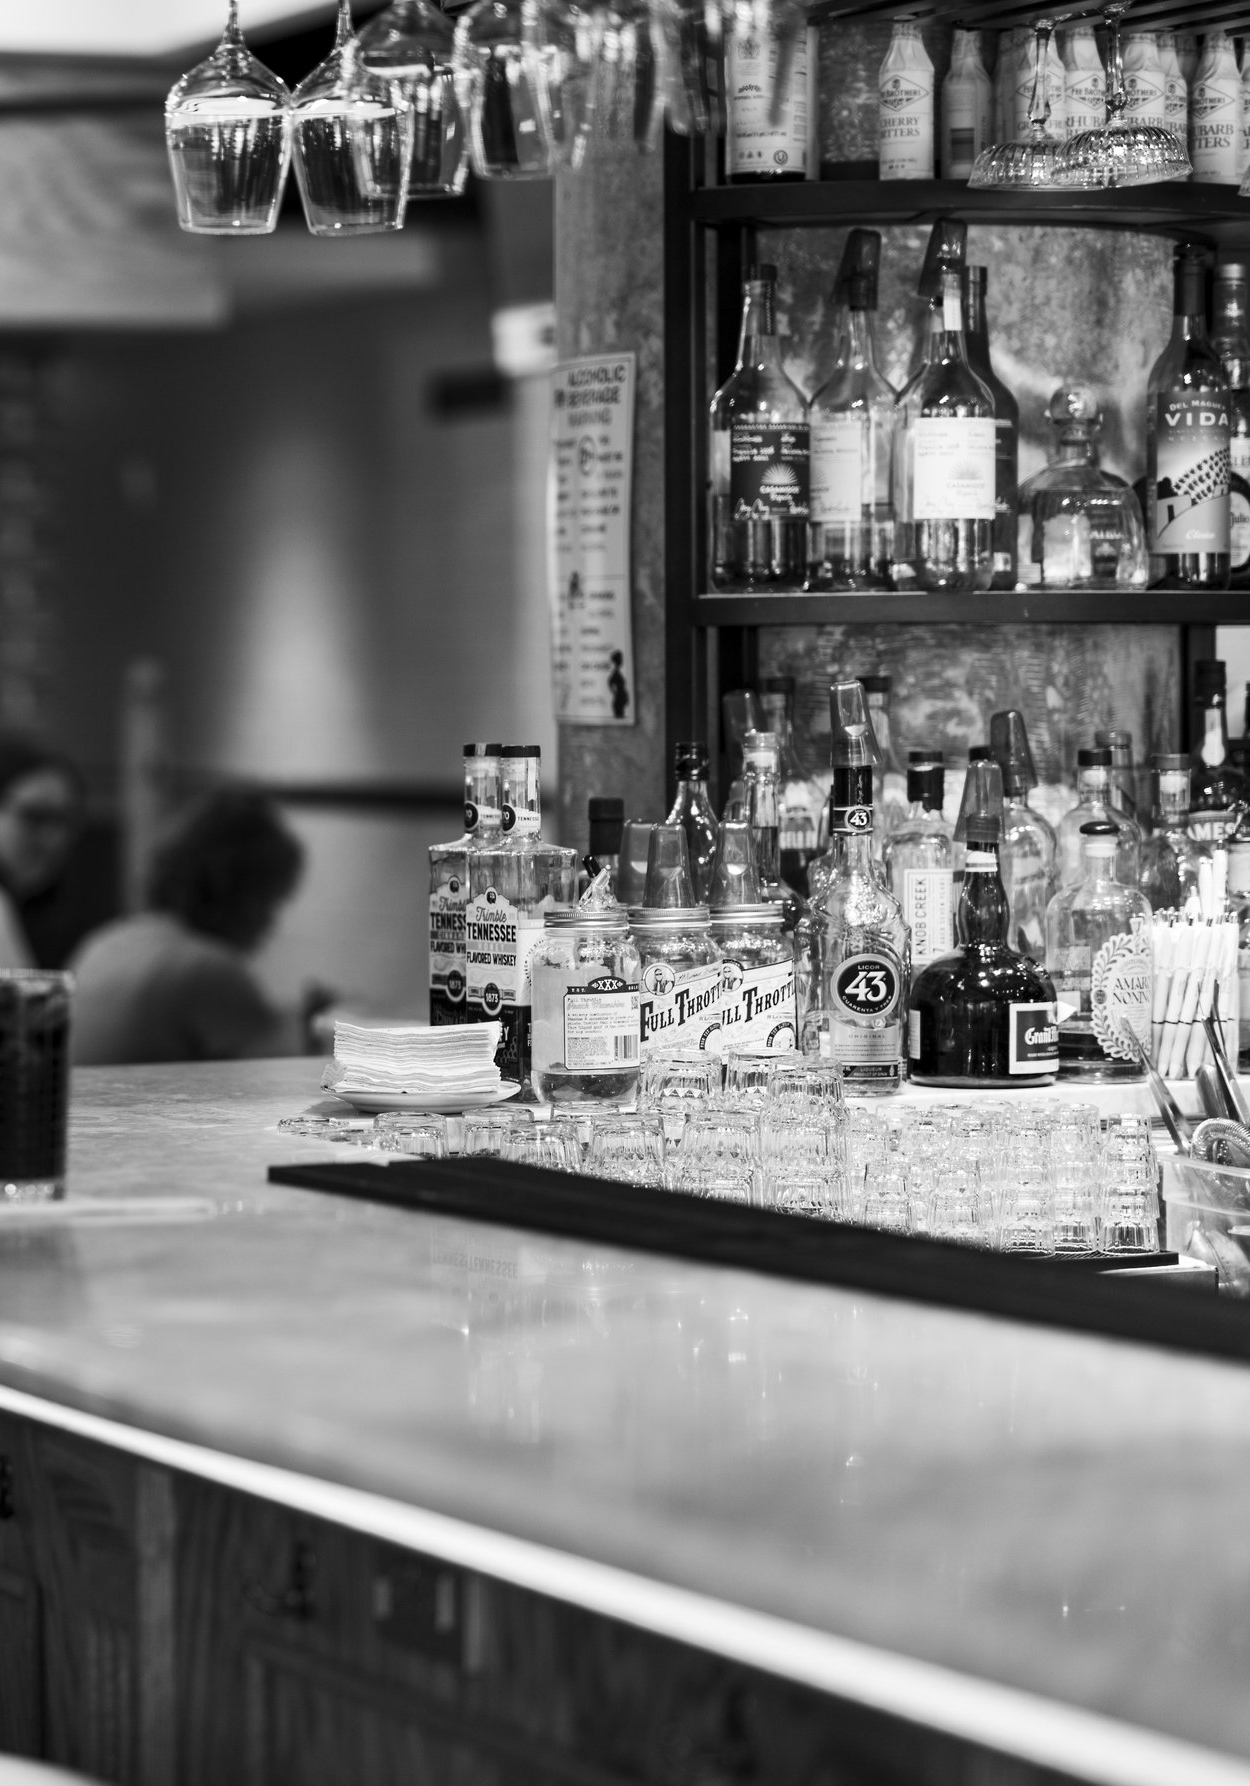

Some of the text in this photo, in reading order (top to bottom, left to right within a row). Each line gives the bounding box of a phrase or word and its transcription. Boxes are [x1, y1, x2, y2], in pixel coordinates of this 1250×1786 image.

[1169, 401, 1186, 412] DEL
[1165, 412, 1229, 427] VIDA
[850, 812, 868, 826] 43
[476, 906, 507, 923] Trimble
[914, 877, 927, 956] KNOB CREEK
[467, 922, 517, 943] TENNESSEE
[467, 951, 516, 967] FLAVORED WHISKEY
[597, 979, 619, 991] XXX
[844, 971, 888, 1002] 43
[485, 992, 499, 1004] 1873
[842, 995, 874, 1012] CUARENTA
[640, 1000, 674, 1043] FULL
